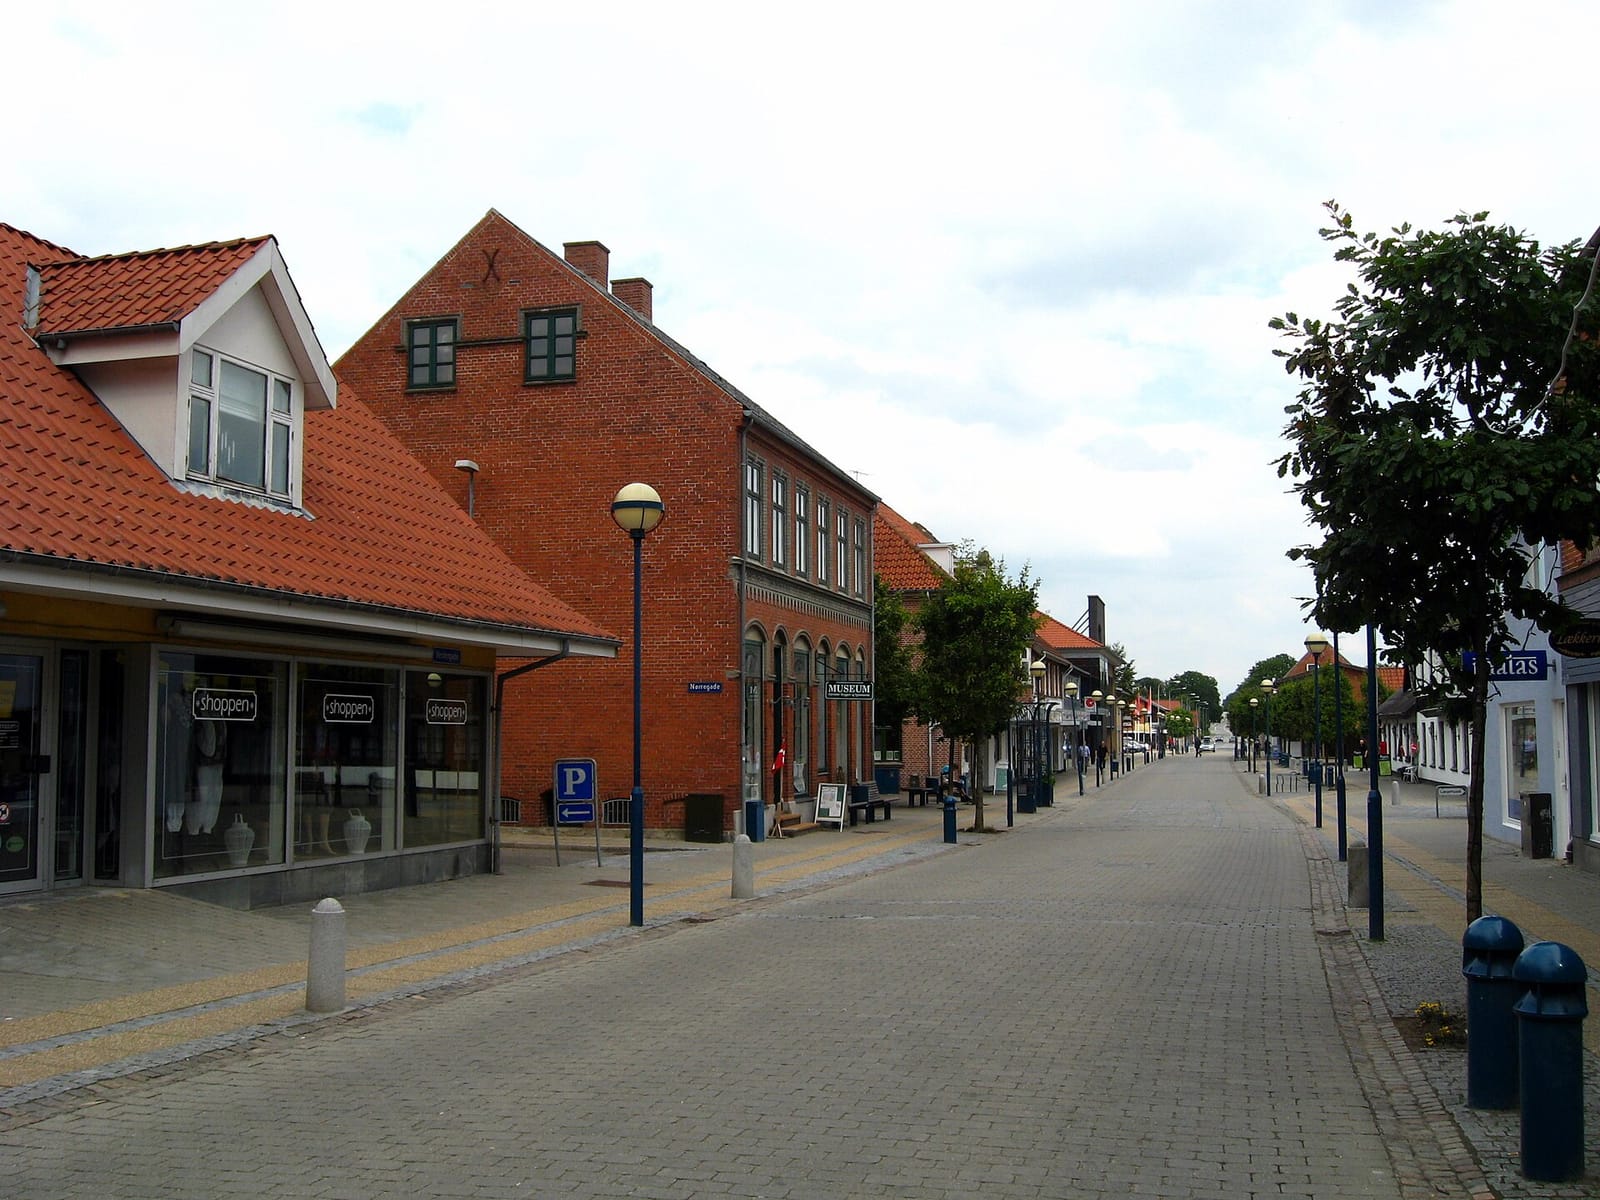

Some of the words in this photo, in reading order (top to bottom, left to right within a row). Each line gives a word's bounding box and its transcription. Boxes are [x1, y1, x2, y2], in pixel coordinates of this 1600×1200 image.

[828, 684, 871, 694] MUSEUM
[200, 693, 249, 717] shoppen
[328, 699, 368, 719] shoppen
[430, 704, 461, 721] shoppen
[563, 767, 586, 796] P
